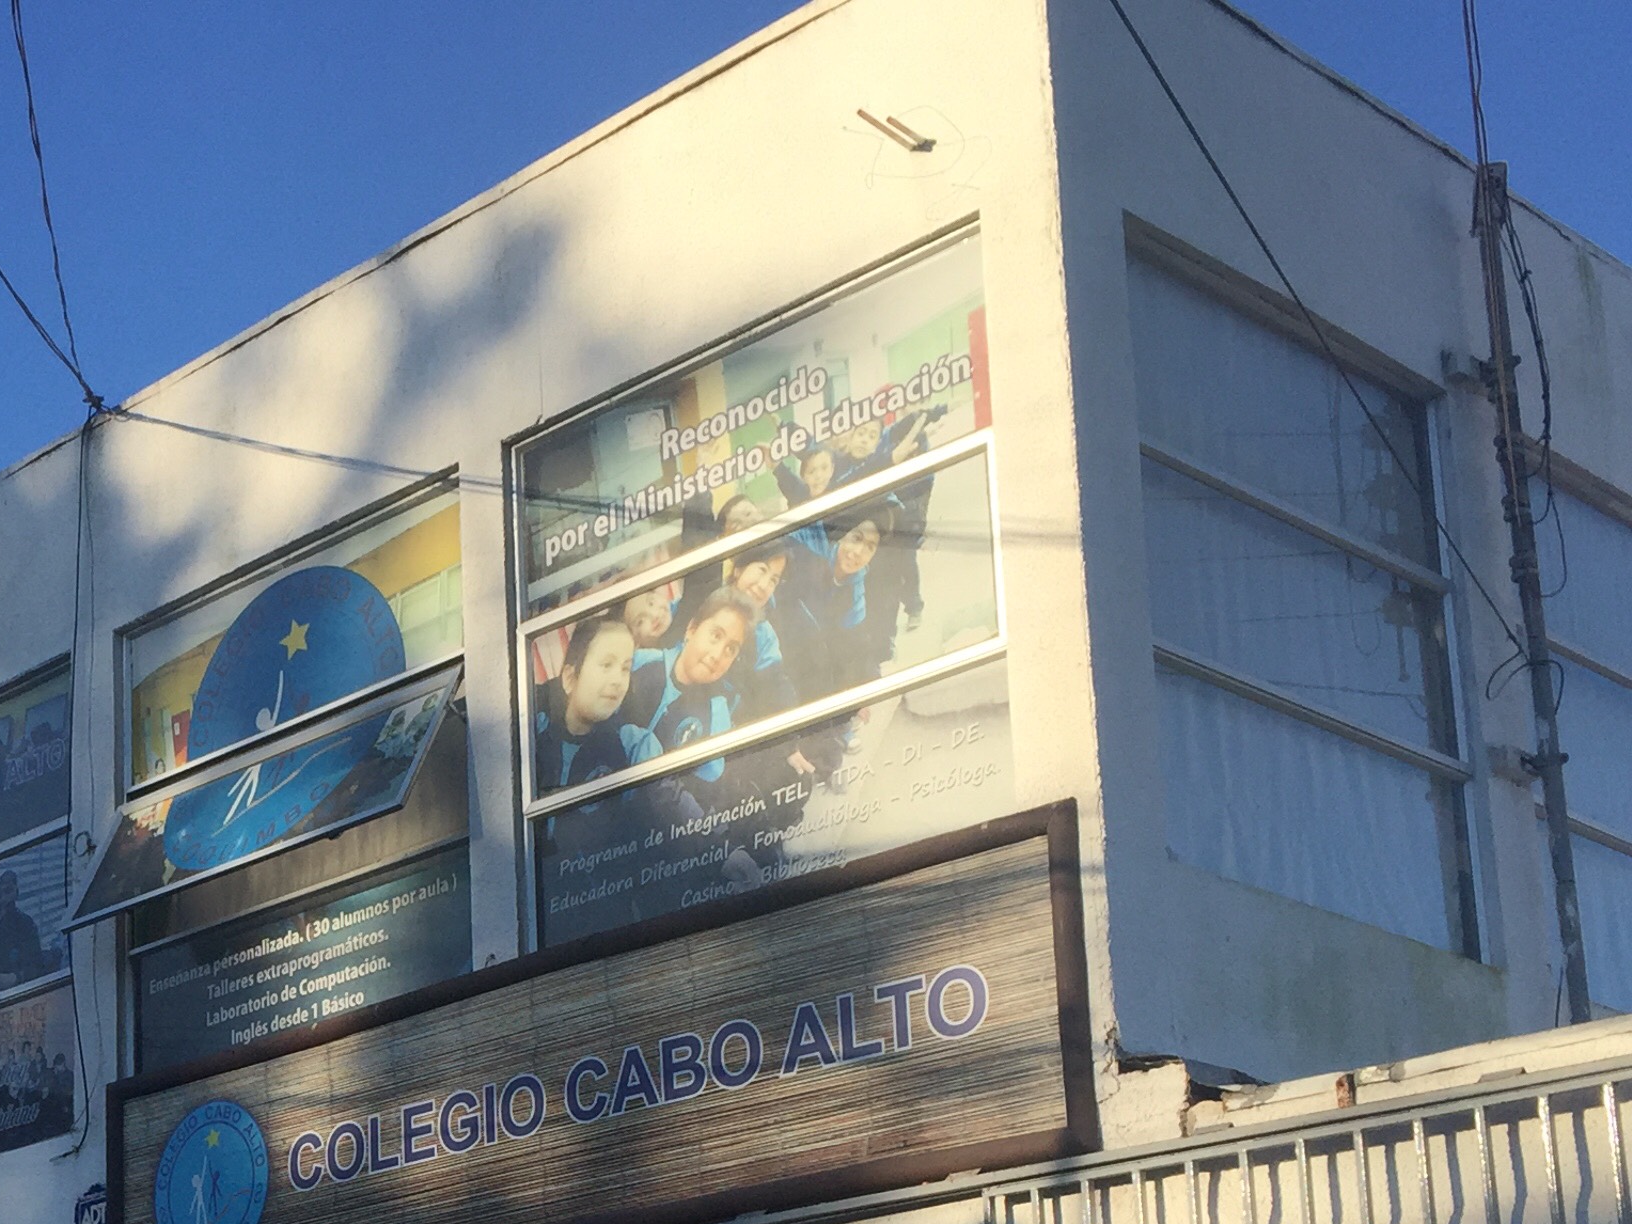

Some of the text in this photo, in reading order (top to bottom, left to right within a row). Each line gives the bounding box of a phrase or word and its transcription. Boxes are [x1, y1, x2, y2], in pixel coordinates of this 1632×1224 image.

[661, 364, 828, 459] Reconocido
[545, 354, 973, 566] por el Ministerio de Educación
[357, 597, 399, 671] ALTO
[4, 738, 65, 790] ALTO
[559, 840, 637, 877] Programa
[644, 829, 663, 848] de
[670, 795, 766, 840] Integración
[772, 784, 808, 806] TEL
[833, 764, 875, 785] TDA
[902, 743, 922, 766] DI
[549, 876, 633, 914] Educadora
[640, 839, 729, 885] Diferencial
[754, 800, 881, 850] Fonoaudióloga
[680, 880, 735, 909] Casino
[148, 962, 211, 996] Enseñanza
[212, 929, 304, 975] personalizada.
[331, 901, 390, 929] alumnos
[391, 891, 416, 914] por
[418, 876, 449, 899] aula
[207, 928, 390, 1000] Talleres extraprogramáticos.
[205, 954, 391, 1028] Laboratorio de Computación.
[231, 991, 365, 1046] Inglés desde 1 Básico
[288, 963, 990, 1192] COLEGIO CABO ALTO
[158, 1104, 265, 1190] COLEGIO CABO ALTO
